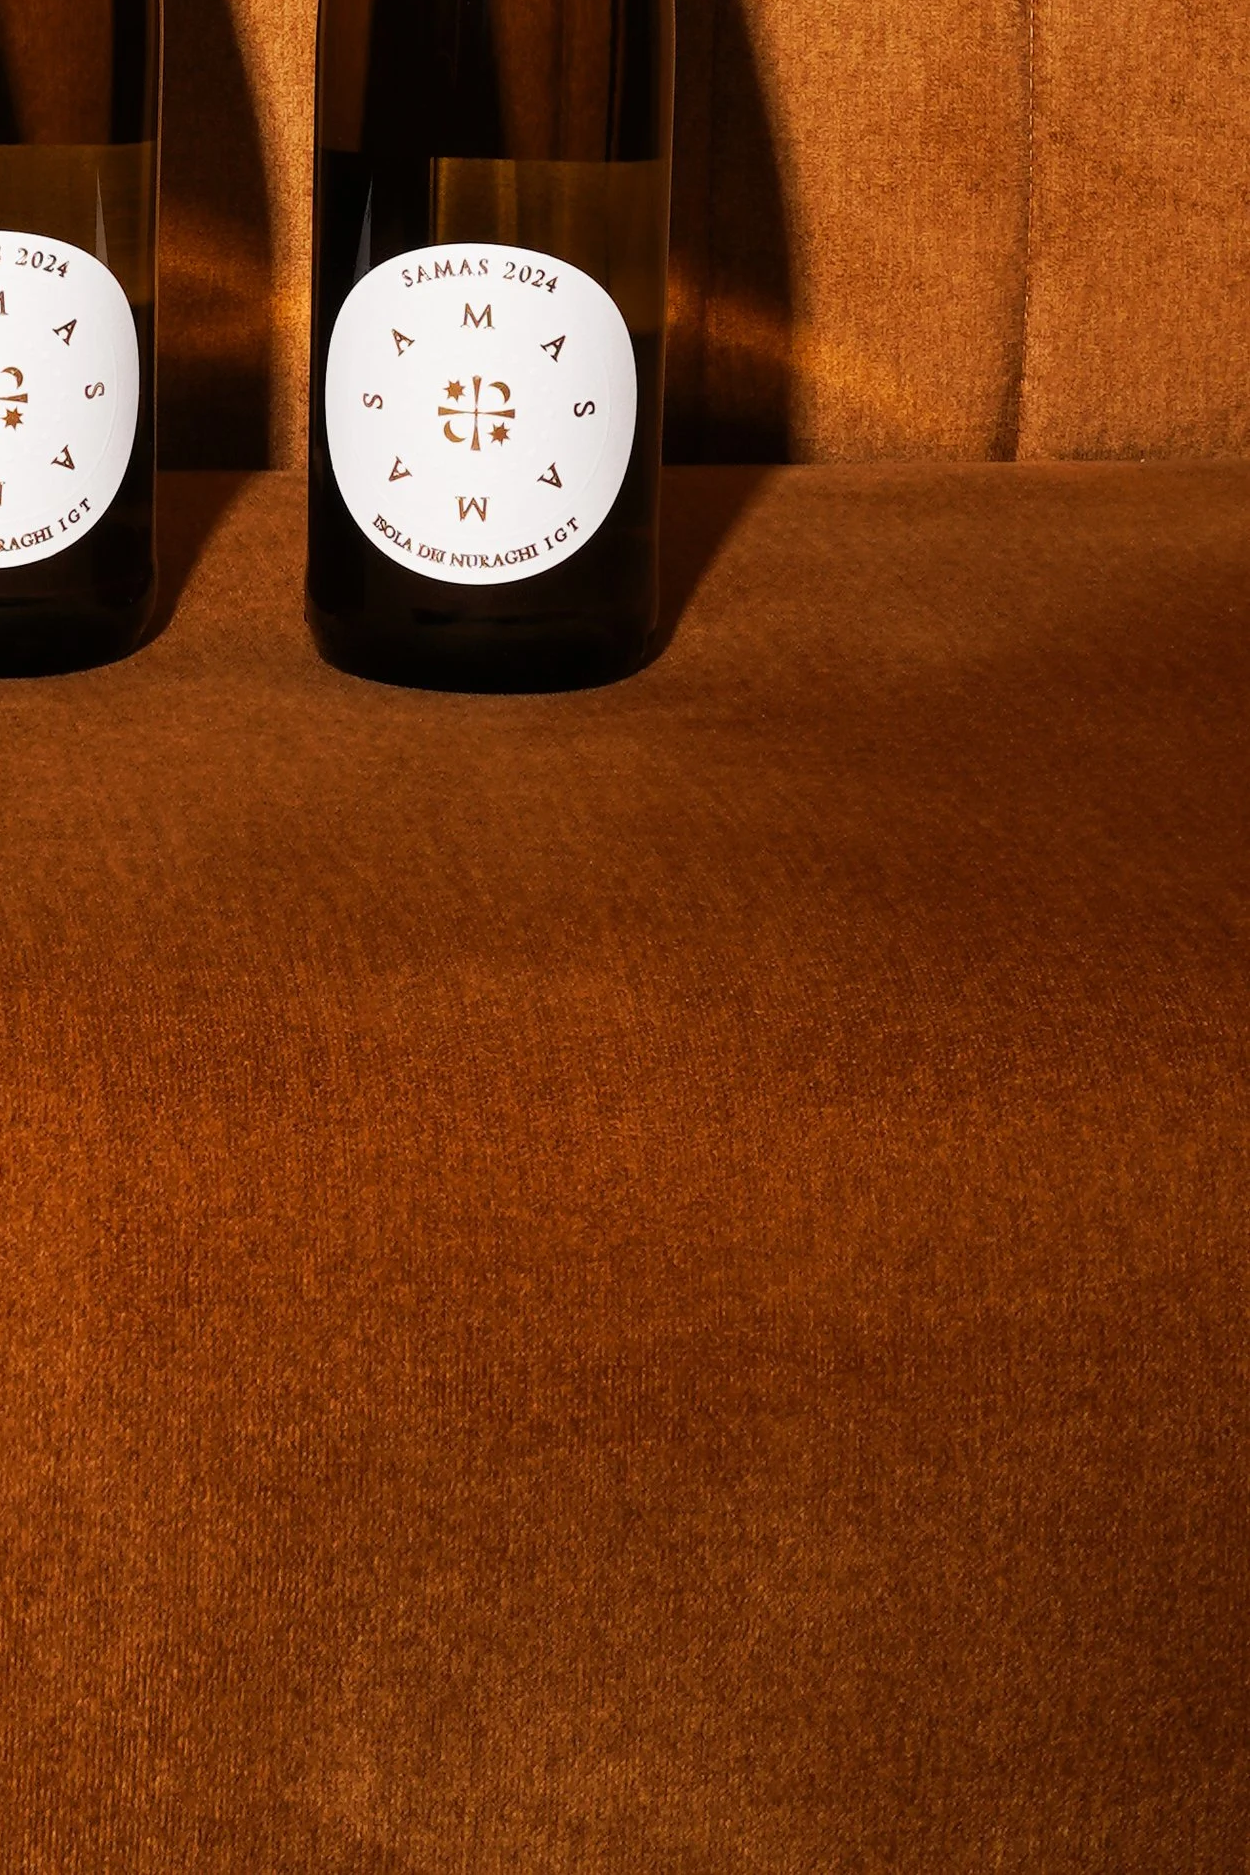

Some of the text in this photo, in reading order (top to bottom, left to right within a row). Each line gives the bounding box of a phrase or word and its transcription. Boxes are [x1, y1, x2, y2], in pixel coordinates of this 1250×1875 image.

[14, 247, 71, 279] 2024
[401, 258, 560, 295] SAMAS 2024
[372, 514, 412, 553] ISOLA
[416, 542, 448, 567] DEI
[448, 542, 541, 572] NURAGHI
